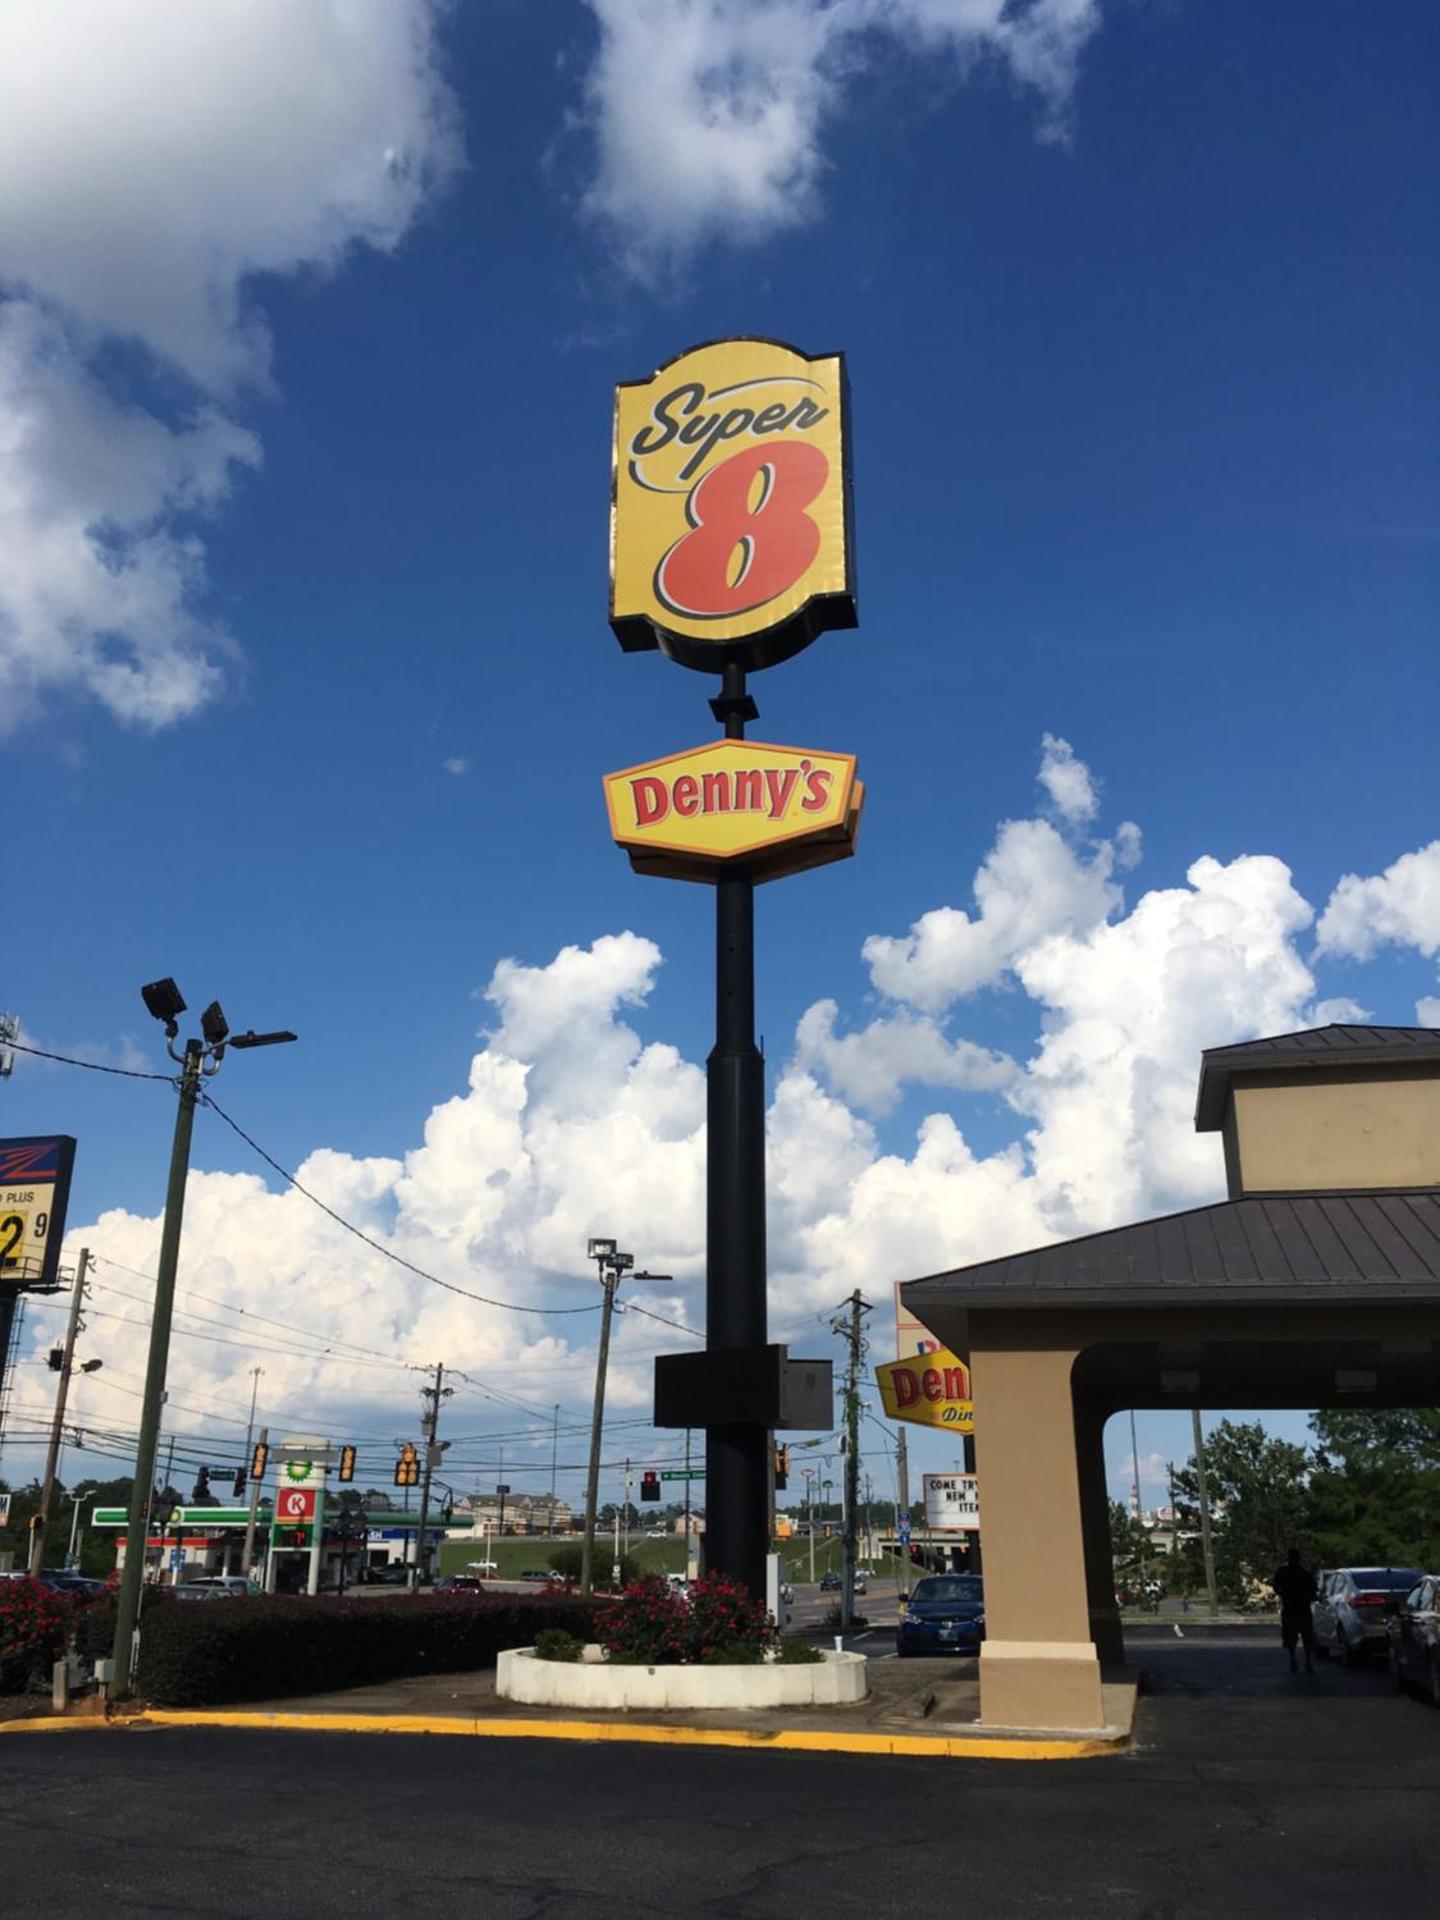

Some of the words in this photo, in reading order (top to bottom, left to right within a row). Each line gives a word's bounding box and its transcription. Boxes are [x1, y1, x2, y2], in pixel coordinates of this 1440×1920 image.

[631, 382, 829, 481] Super
[653, 440, 829, 621] 8
[629, 759, 832, 826] Denny's
[7, 1191, 35, 1203] PLUS
[0, 1216, 23, 1267] 2
[34, 1213, 47, 1238] 9
[291, 1497, 302, 1513] K
[930, 1480, 956, 1490] COME
